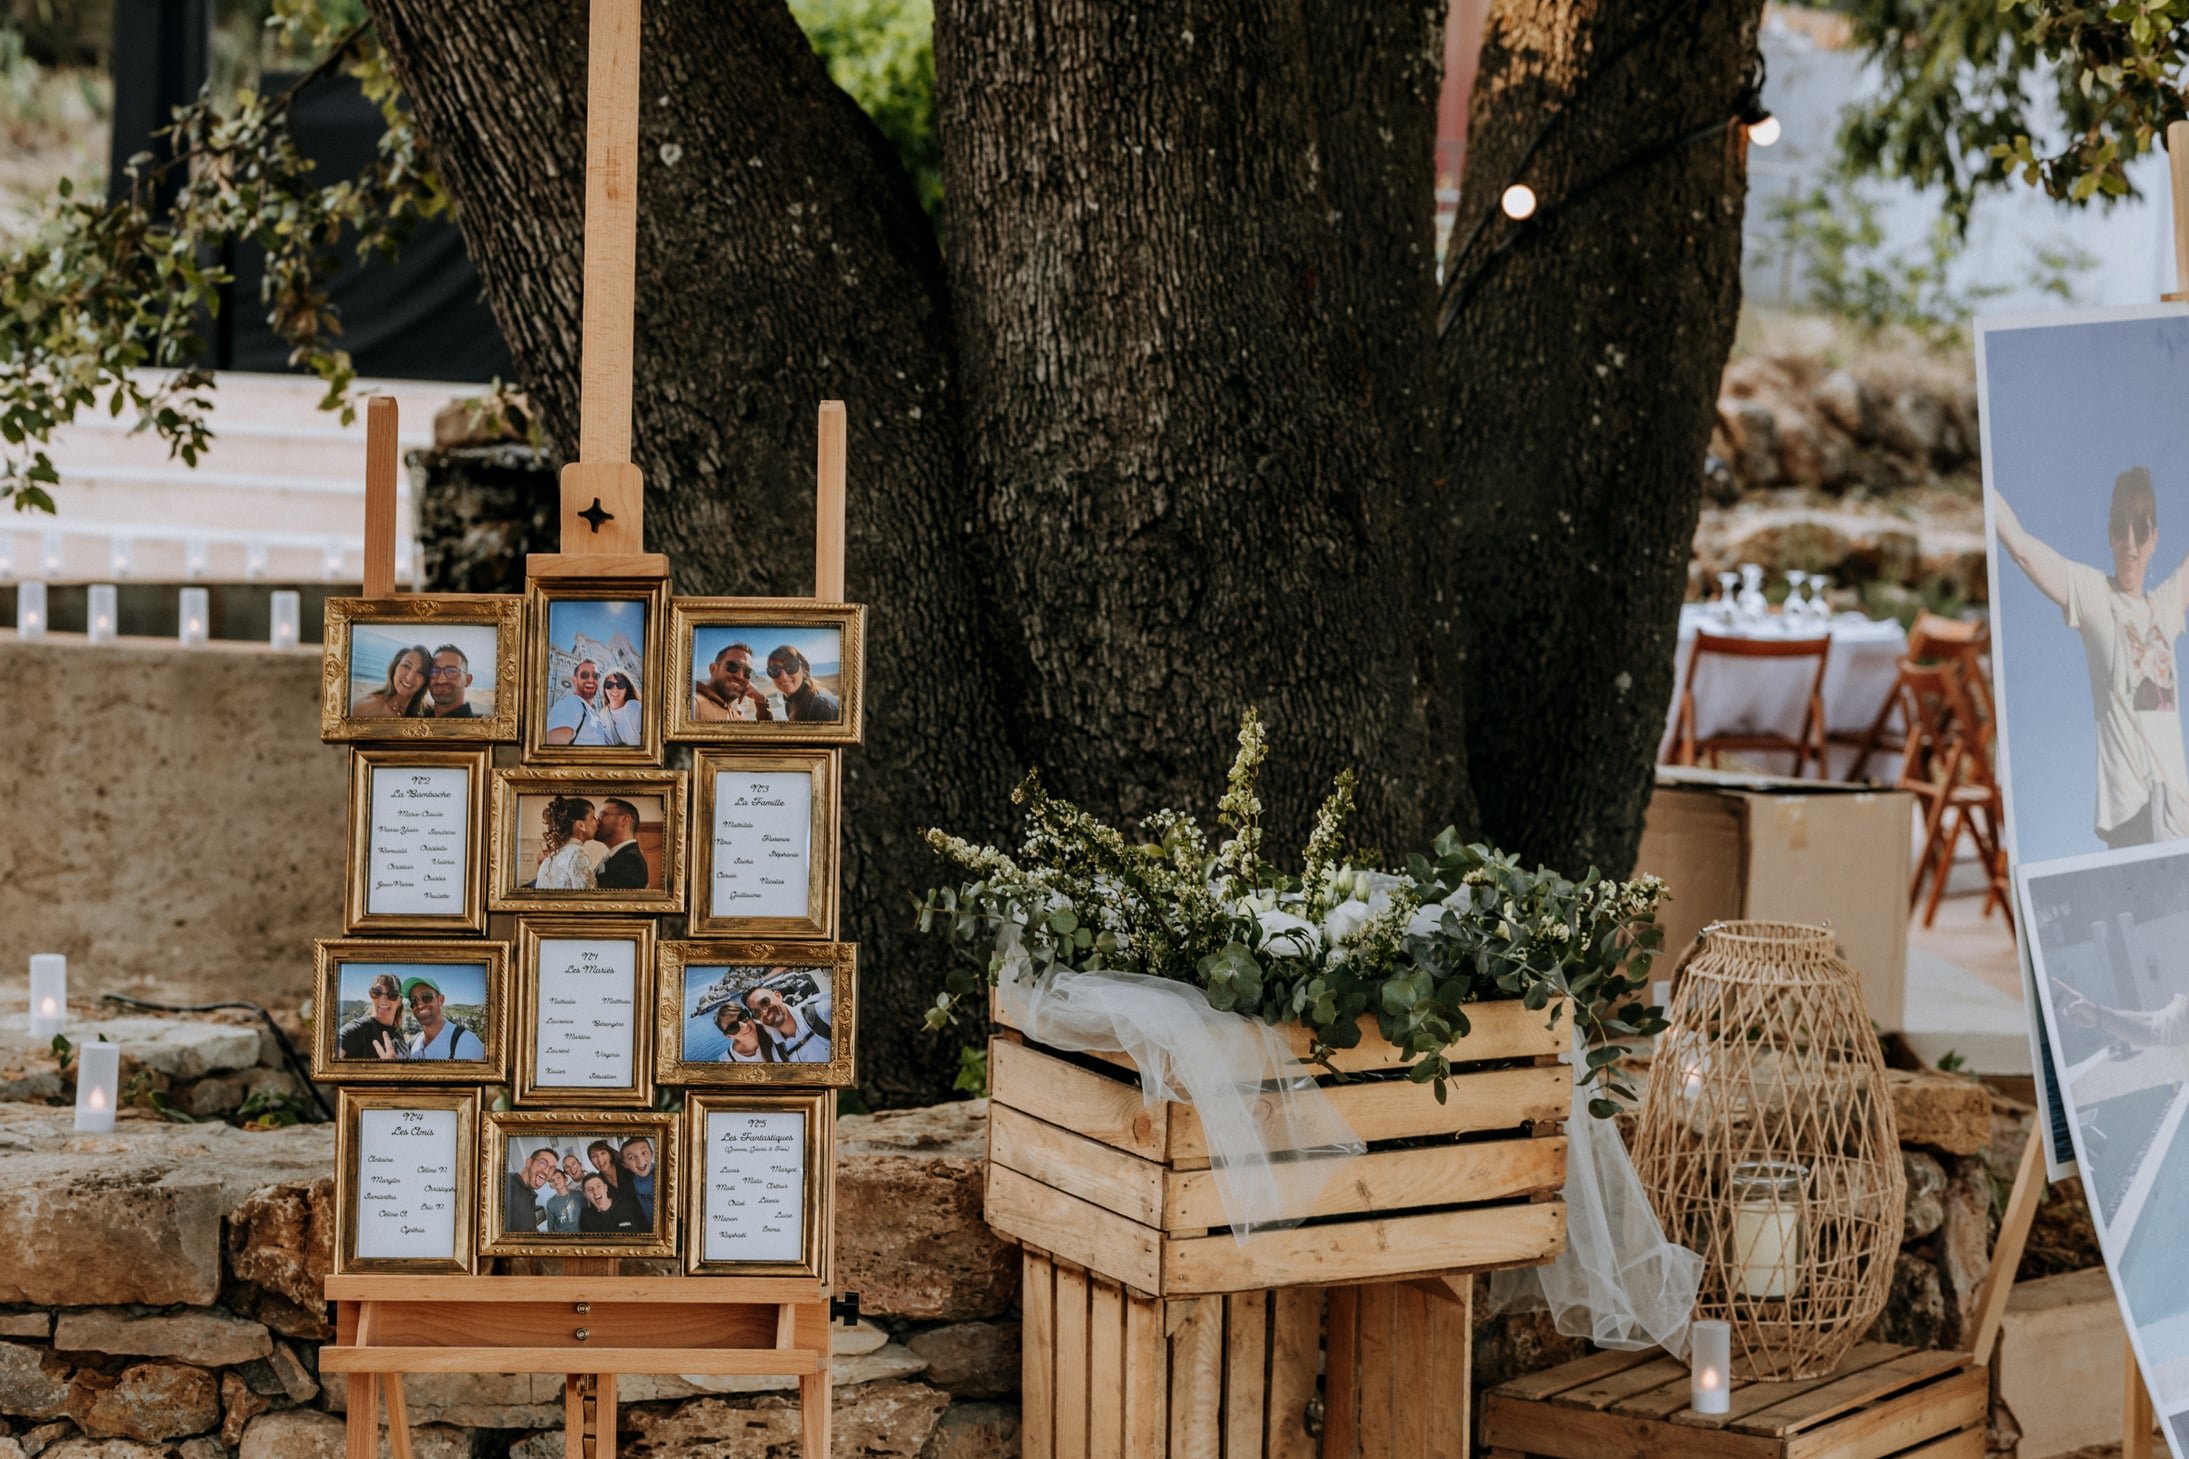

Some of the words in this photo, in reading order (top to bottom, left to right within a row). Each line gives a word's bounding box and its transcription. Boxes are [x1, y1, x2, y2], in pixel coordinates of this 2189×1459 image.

[411, 776, 431, 784] N°2
[750, 784, 770, 793] N°3
[390, 789, 404, 798] La
[406, 789, 451, 798] Bamboche
[734, 797, 748, 806] La
[751, 797, 785, 806] Famille
[564, 965, 581, 974] Les
[583, 965, 614, 974] Mariés
[402, 1112, 423, 1121] N°4
[747, 1119, 767, 1128] N°5
[391, 1126, 409, 1135] Les
[411, 1126, 434, 1136] Amis
[721, 1132, 738, 1141] Les
[740, 1132, 794, 1143] Fantastiques
